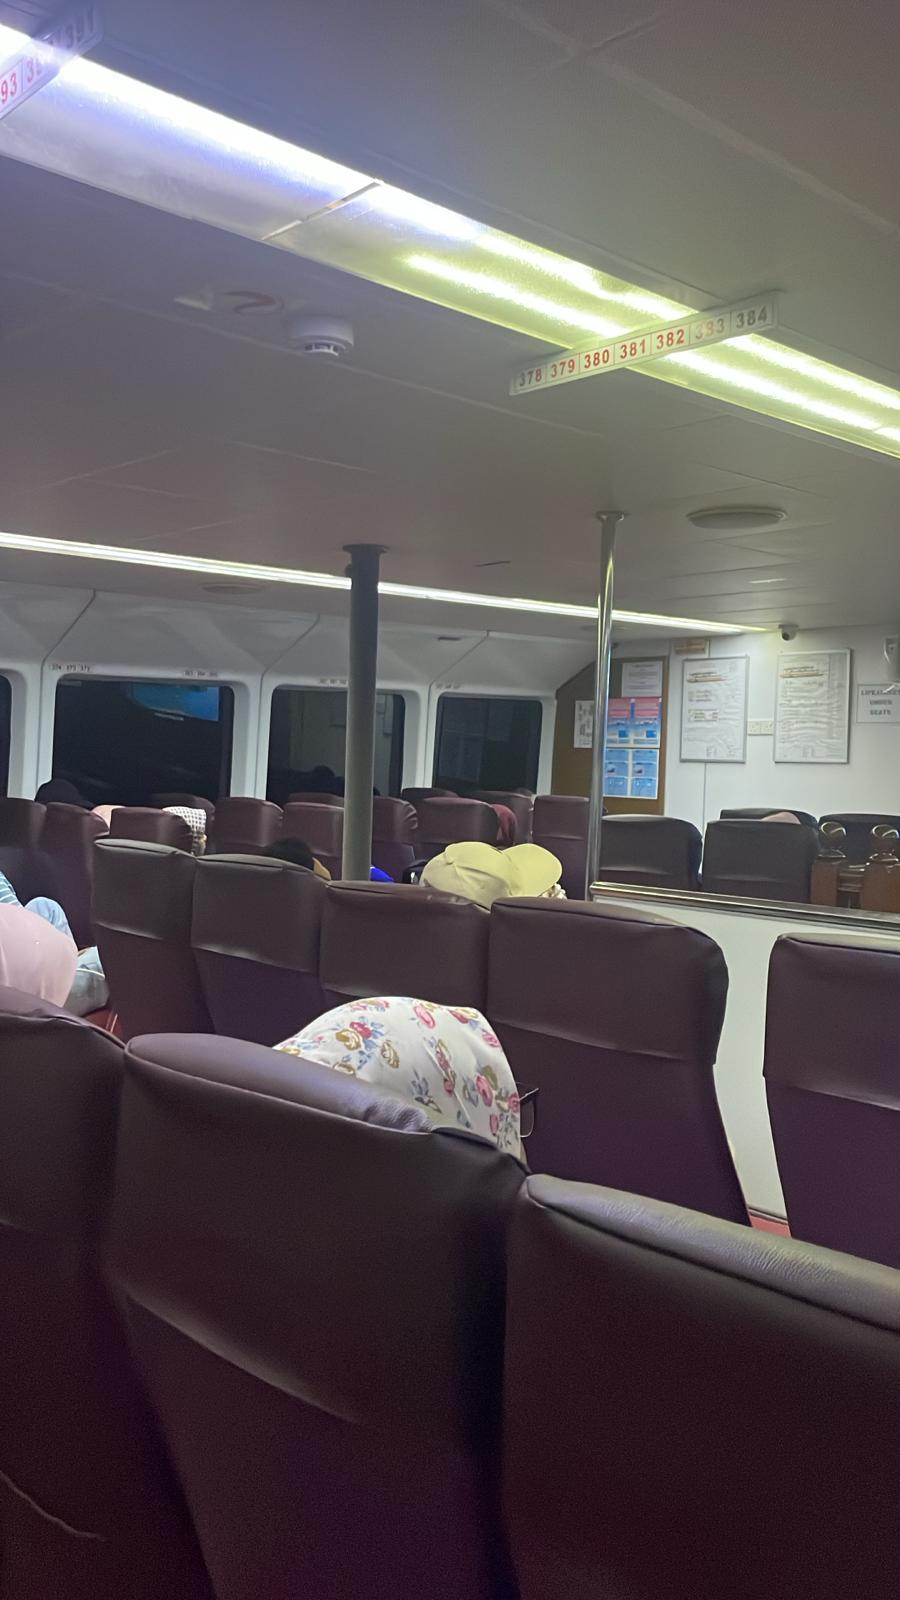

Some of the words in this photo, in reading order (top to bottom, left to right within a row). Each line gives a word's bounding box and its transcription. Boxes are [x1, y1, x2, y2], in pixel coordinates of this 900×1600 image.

[519, 367, 543, 387] 378
[550, 358, 575, 378] 379
[584, 349, 610, 369] 380
[620, 339, 646, 359] 381
[656, 329, 685, 350] 382
[695, 318, 725, 340] 383
[736, 306, 768, 329] 384
